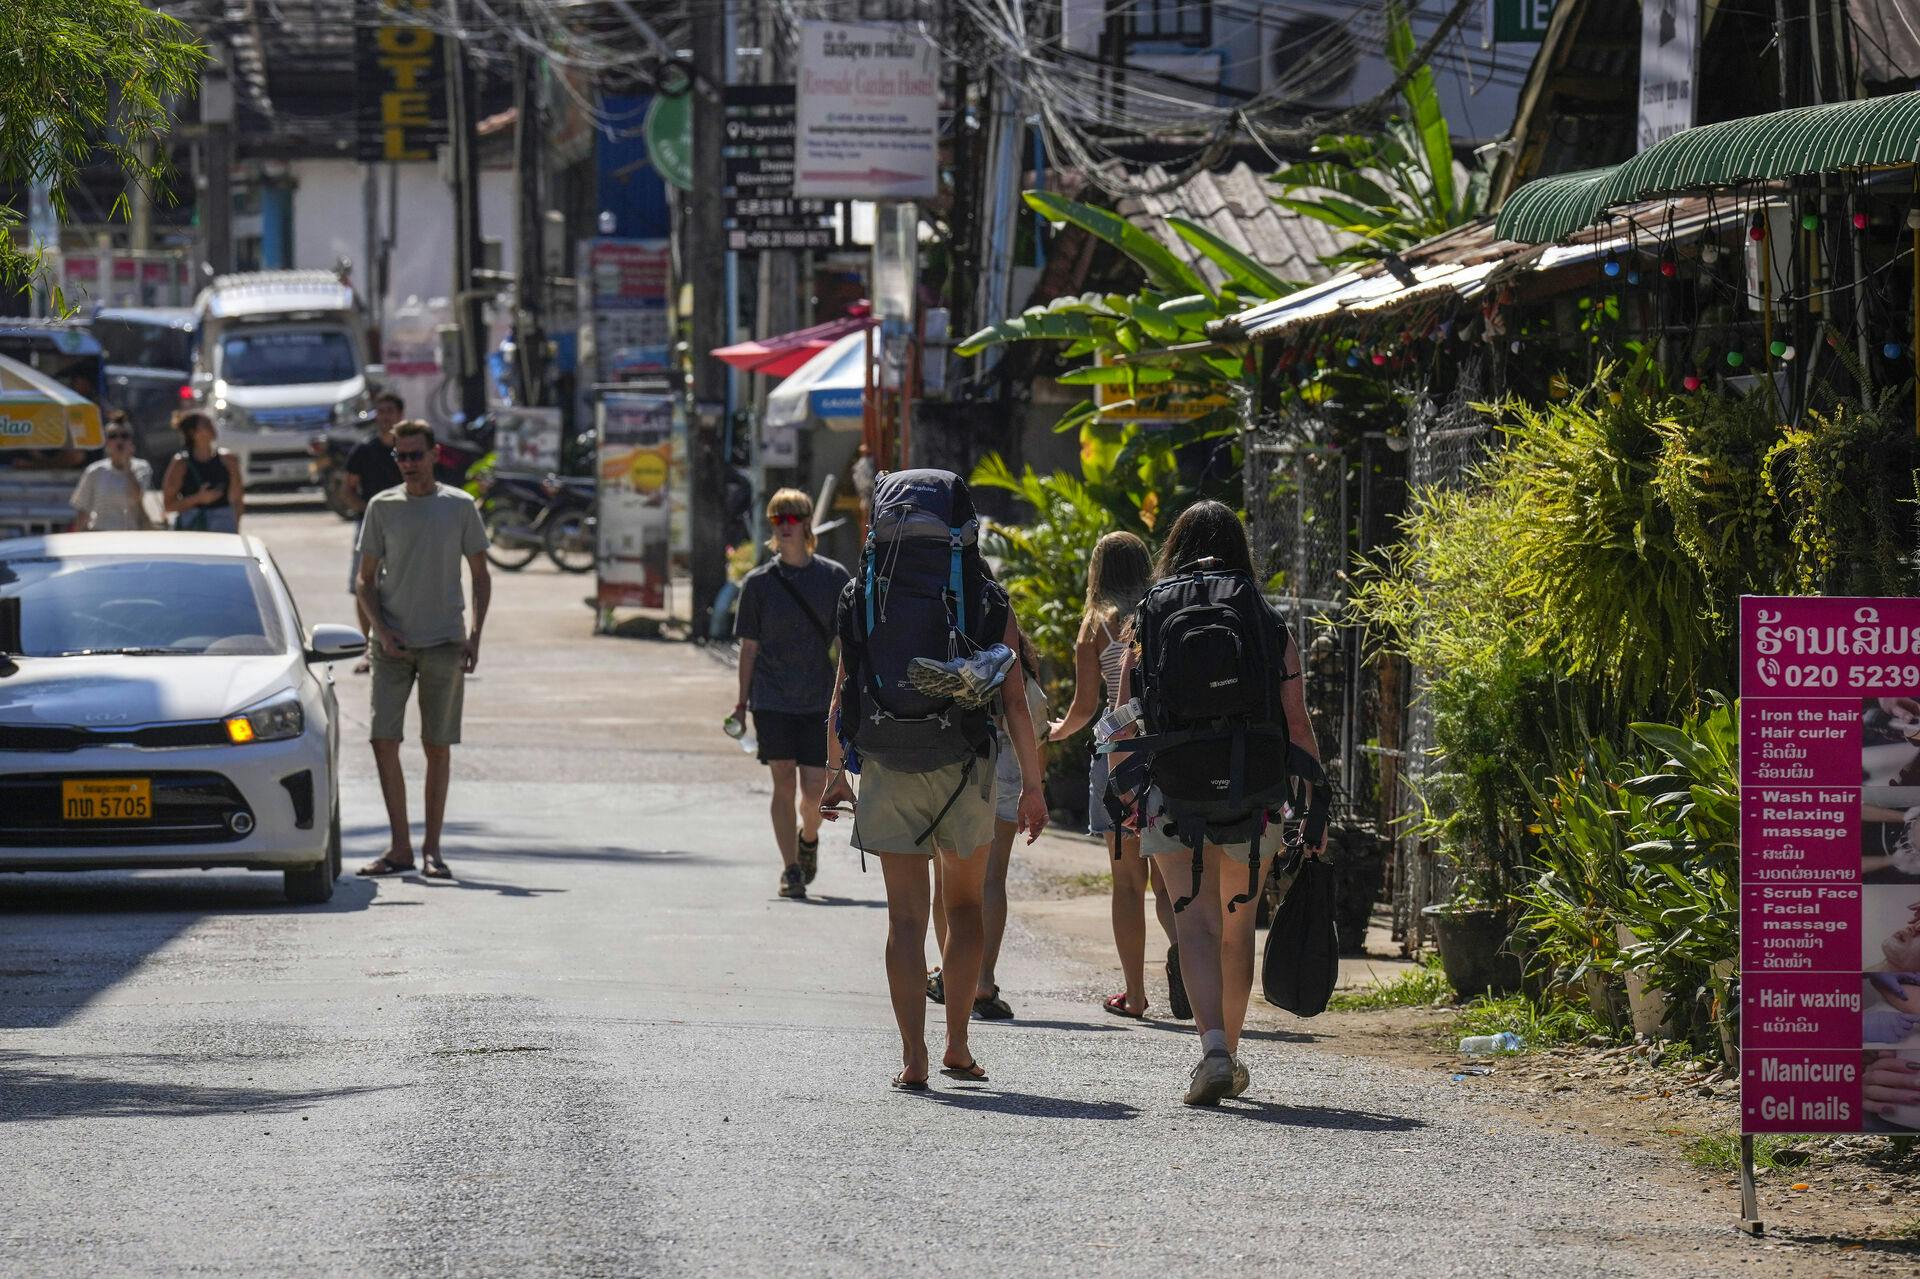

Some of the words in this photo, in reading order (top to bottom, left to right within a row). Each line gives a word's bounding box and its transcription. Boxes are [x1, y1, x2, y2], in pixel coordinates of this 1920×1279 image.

[375, 0, 434, 161] OTEL
[0, 417, 32, 434] lao
[1784, 665, 1838, 687] 020
[1761, 709, 1792, 721] Iron
[1797, 709, 1823, 721] the
[1828, 709, 1859, 721] hair
[1761, 726, 1794, 738] Hair
[1798, 726, 1846, 738] curler
[1762, 790, 1812, 802] Wash
[1819, 791, 1855, 802] hair
[100, 796, 147, 817] 5705
[1762, 808, 1844, 822] Relaxing
[1762, 827, 1847, 840] massage
[1763, 887, 1812, 898] Scrub
[1817, 887, 1857, 898] Face
[1763, 903, 1819, 913] Facial
[1763, 921, 1847, 932] massage
[1760, 988, 1795, 1007] Hair
[1799, 988, 1860, 1012] waxing
[1761, 1057, 1855, 1082] Manicure
[1760, 1095, 1794, 1120] Gel
[1801, 1095, 1849, 1120] nails
